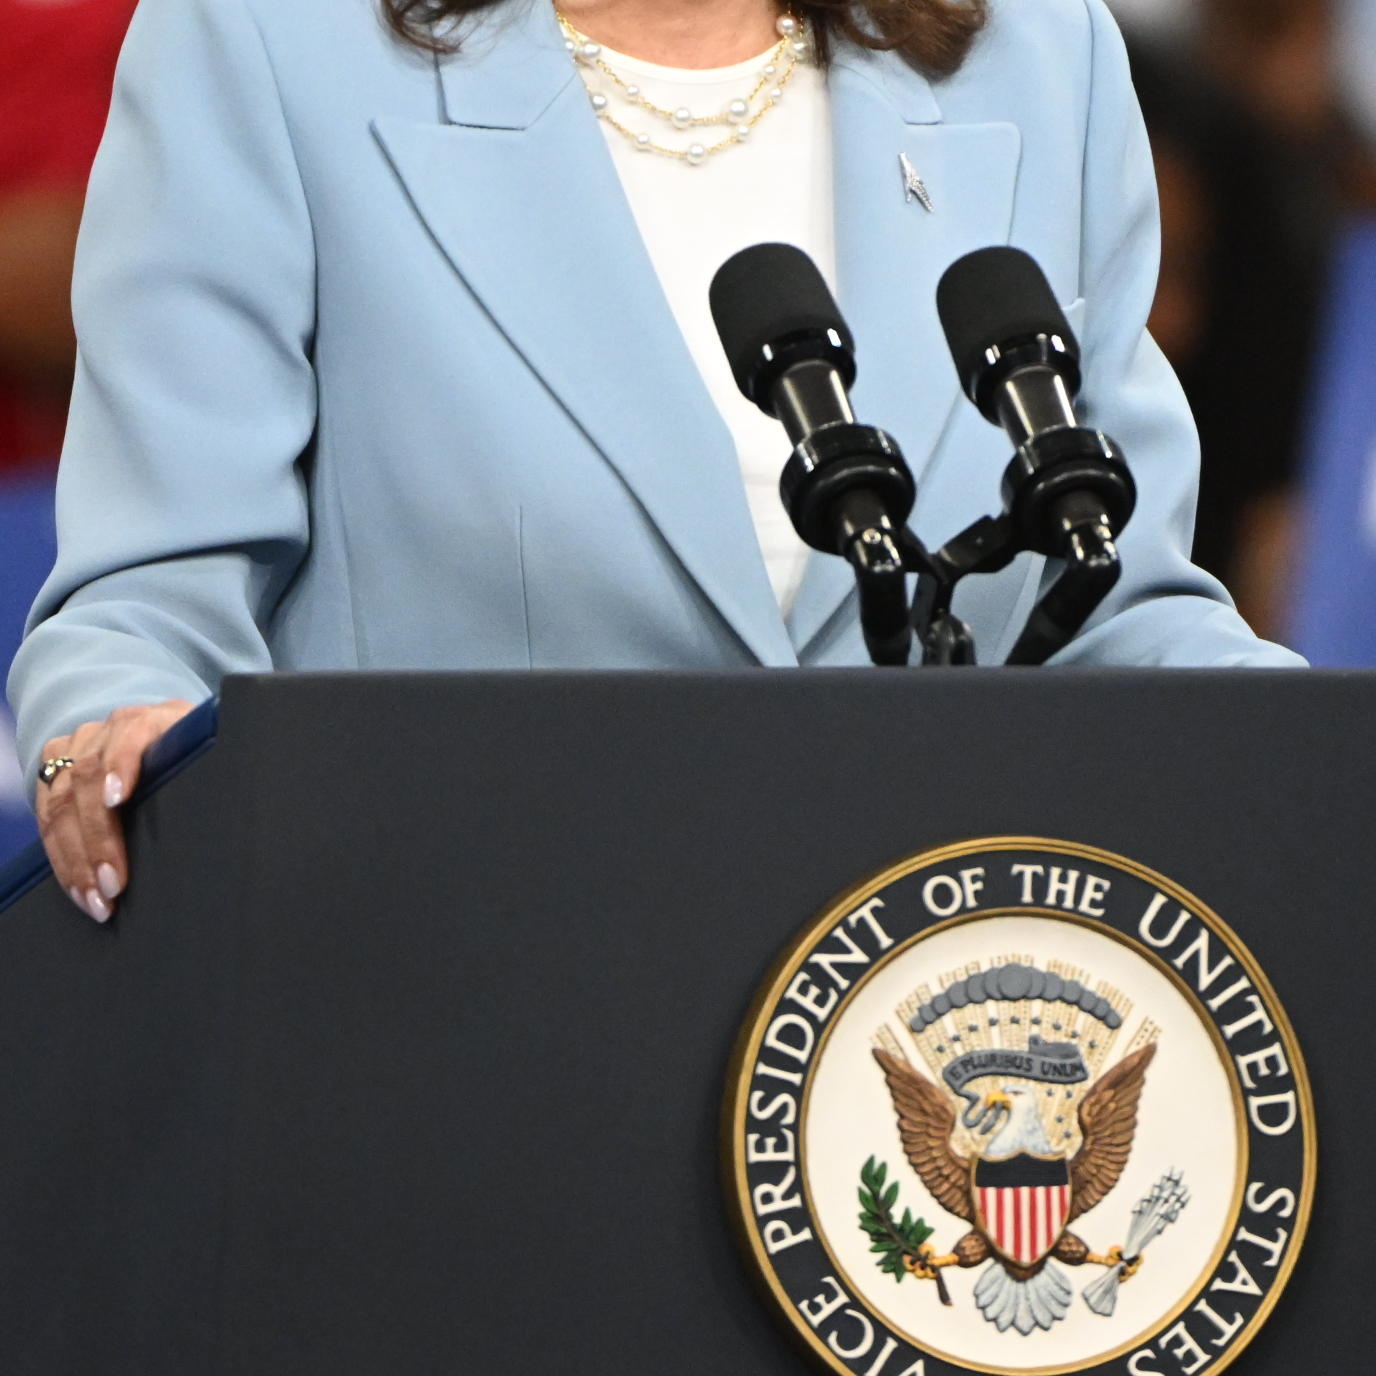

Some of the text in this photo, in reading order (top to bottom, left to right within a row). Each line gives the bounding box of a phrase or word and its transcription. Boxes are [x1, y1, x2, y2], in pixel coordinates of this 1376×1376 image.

[746, 897, 900, 1255] PRESIDENT
[922, 867, 986, 918] OF
[1010, 863, 1112, 917] THE
[1137, 893, 1298, 1137] UNITED
[959, 1053, 1034, 1074] PLURIBUS
[1040, 1060, 1086, 1077] UNUM
